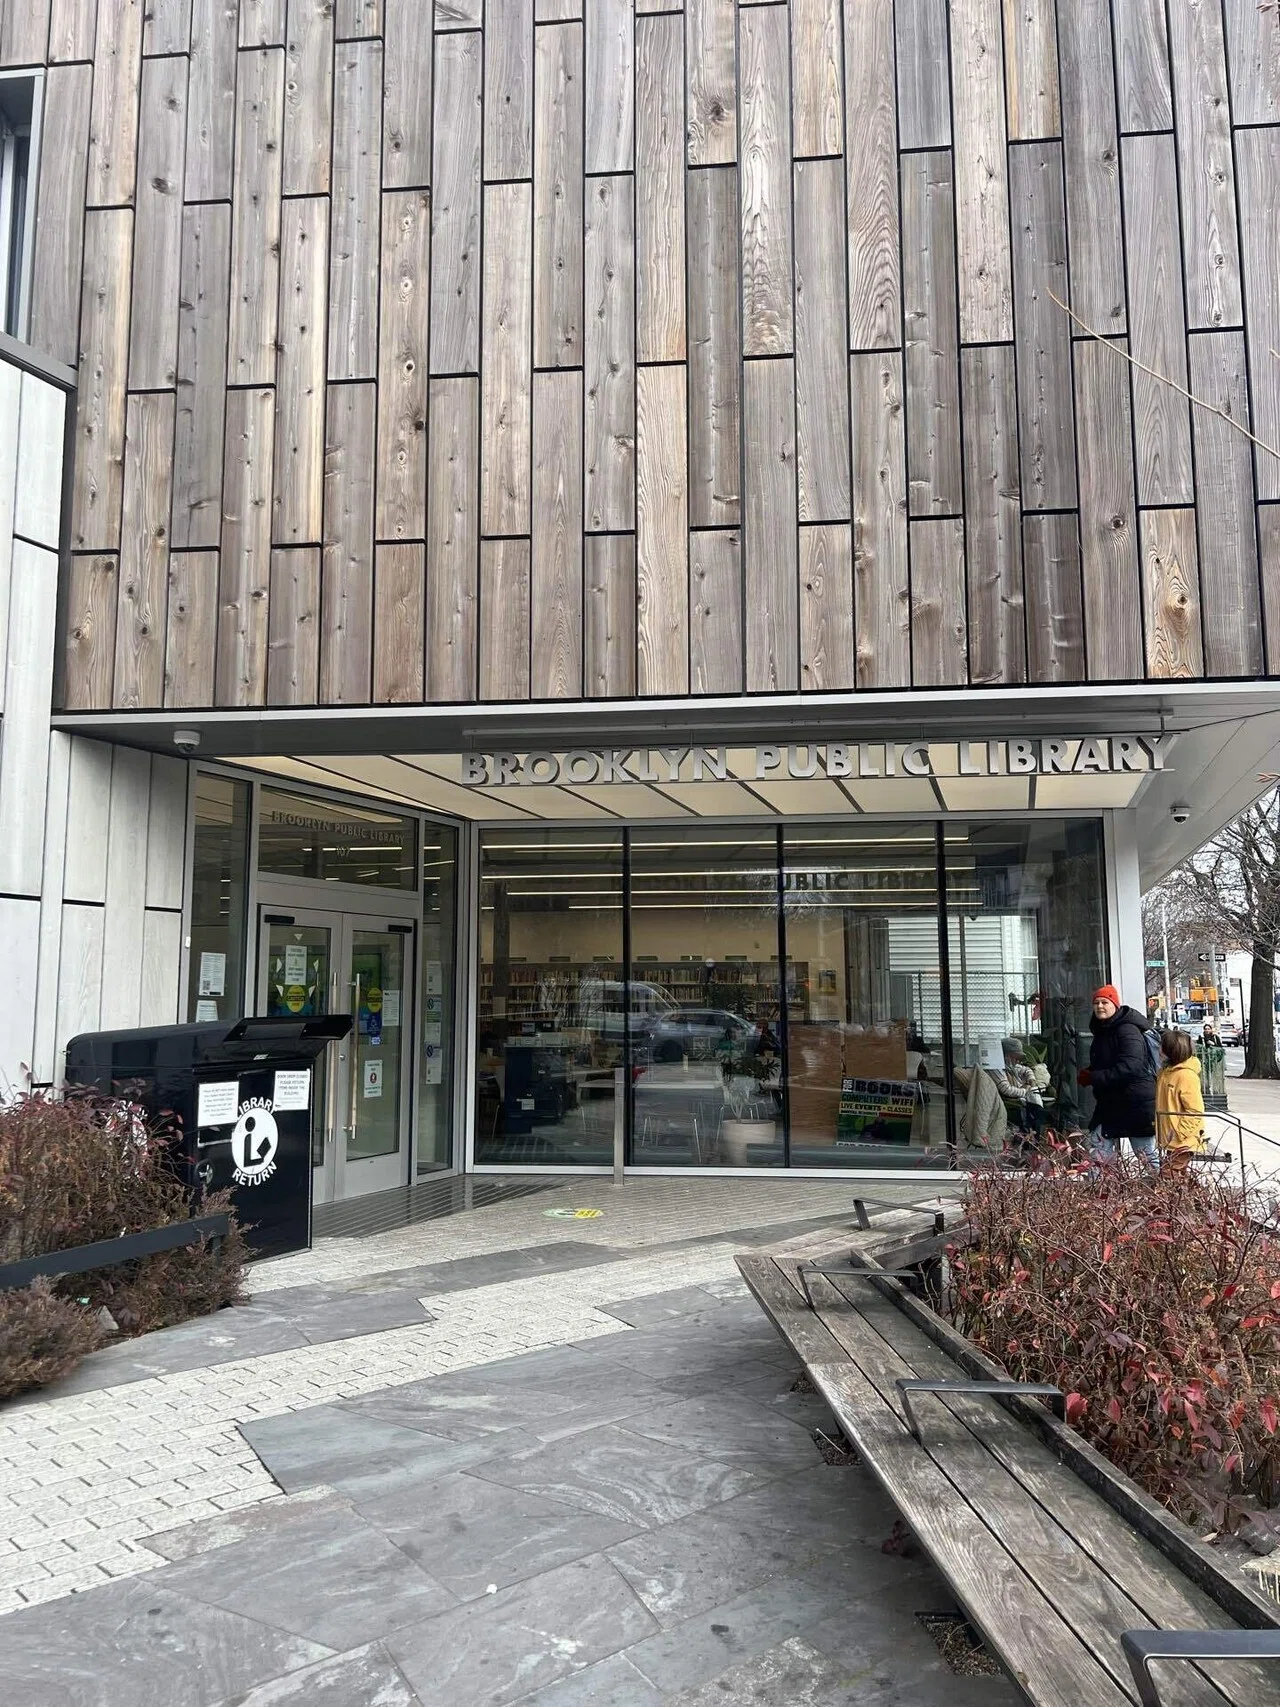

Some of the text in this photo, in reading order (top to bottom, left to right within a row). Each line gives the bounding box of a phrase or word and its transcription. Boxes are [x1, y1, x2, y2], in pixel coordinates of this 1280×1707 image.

[462, 734, 1174, 785] BROOKLYN PUBLIC LIBRARY
[272, 810, 405, 845] BROOKLYN PUBLIC LIBRARY
[841, 1093, 913, 1106] COMPUTERS WIFI
[842, 1079, 914, 1096] FOR BOOKS
[232, 1161, 277, 1187] RETURN
